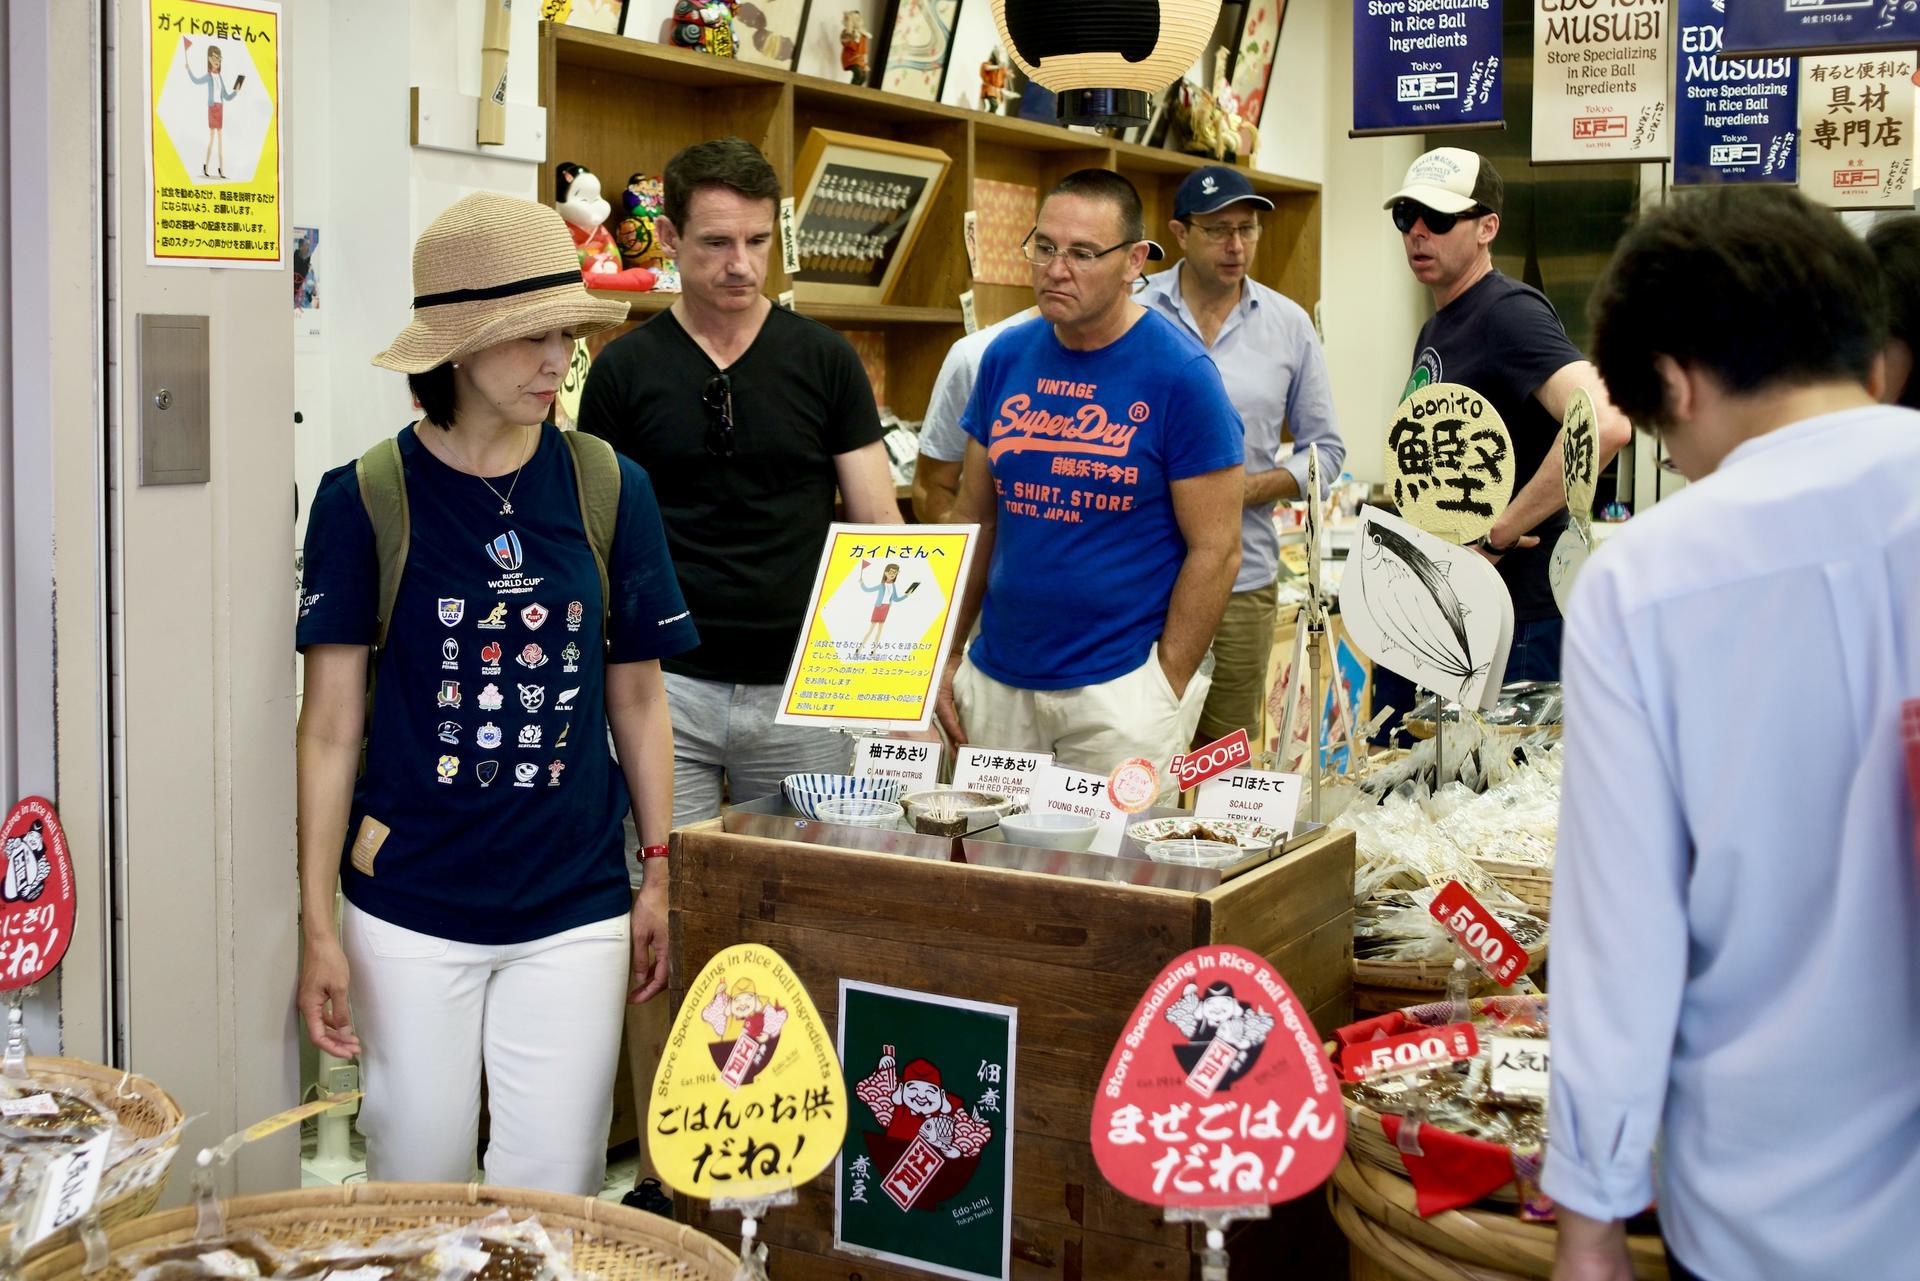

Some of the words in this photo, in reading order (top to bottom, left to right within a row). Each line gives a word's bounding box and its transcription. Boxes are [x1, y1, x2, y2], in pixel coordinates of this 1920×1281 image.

[1368, 0, 1405, 16] Store
[1408, 0, 1490, 14] Specializing
[158, 13, 271, 43] ガイドの皆さんへ
[1390, 18, 1404, 33] in
[1406, 16, 1436, 31] Rice
[1438, 12, 1467, 29] Ball
[1545, 10, 1660, 46] MUSUBI
[1388, 31, 1468, 53] Ingredients
[1547, 51, 1580, 64] Store
[1583, 46, 1657, 63] Specializing
[1410, 61, 1443, 72] Tokyo
[1567, 66, 1578, 79] in
[1581, 65, 1607, 78] Rice
[1611, 63, 1635, 77] Ball
[1685, 54, 1791, 82] MUSUBI
[1810, 61, 1911, 82] 有ると便利な
[1566, 80, 1637, 97] Ingredients
[1687, 86, 1718, 98] Store
[1720, 83, 1788, 98] Specializing
[1826, 83, 1890, 114] 具材
[1585, 105, 1613, 114] Tokyo
[1706, 100, 1716, 111] in
[1719, 99, 1743, 111] Rice
[1745, 98, 1768, 110] Ball
[1576, 118, 1624, 136] 江戸一
[1704, 112, 1769, 128] Ingredients
[1721, 134, 1748, 143] Tokyo
[1810, 117, 1903, 150] 専門店
[1836, 172, 1877, 185] 江戸一
[1036, 377, 1097, 400] VINTAGE
[1409, 392, 1484, 420] bonito
[1014, 481, 1065, 505] SHIRT.
[1070, 489, 1137, 512] STORE.
[1006, 500, 1040, 518] TOKYO,
[1043, 506, 1084, 523] JAPAN.
[487, 579, 522, 588] WORLD
[502, 572, 524, 580] RUGBY
[868, 742, 929, 762] 柚子あさり
[1182, 741, 1245, 781] 500円
[971, 754, 1037, 773] ピリ辛あさり
[867, 768, 883, 776] CAM
[886, 769, 901, 777] WITH
[901, 771, 923, 780] CITRUS
[978, 774, 1000, 783] ASARI
[1002, 776, 1023, 785] CLAM
[1218, 776, 1285, 792] 一口ほたて
[967, 782, 985, 791] WITH
[986, 784, 1001, 792] RED
[1065, 776, 1105, 796] しらす
[1047, 800, 1072, 811] YOUNG
[1229, 799, 1263, 810] SCALLOP
[21, 805, 29, 815] in
[30, 801, 46, 817] Rice
[44, 814, 57, 833] Ball
[53, 831, 70, 900] Ingredients
[0, 903, 55, 938] にぎり
[658, 1052, 677, 1097] Store
[673, 963, 726, 1048] Specializing
[727, 953, 740, 967] in
[743, 950, 772, 968] Rice
[772, 964, 796, 994] Ball
[792, 991, 831, 1080] Ingredients
[1105, 1048, 1134, 1099] Store
[1125, 960, 1197, 1048] Specializing
[1197, 954, 1215, 969] in
[1219, 951, 1256, 974] Rice
[1254, 967, 1286, 1002] Ball
[1278, 997, 1329, 1095] Ingredients
[724, 1040, 753, 1085] 江戸一
[976, 1059, 1001, 1113] 佃煮
[657, 1085, 834, 1135] ごはんのお供
[1107, 1096, 1336, 1145] まぜごはん
[848, 1154, 871, 1204] 煮豆
[887, 1142, 937, 1204] 江戸一
[952, 1196, 990, 1218] Edo-Ichi
[956, 1215, 974, 1226] Tokyo
